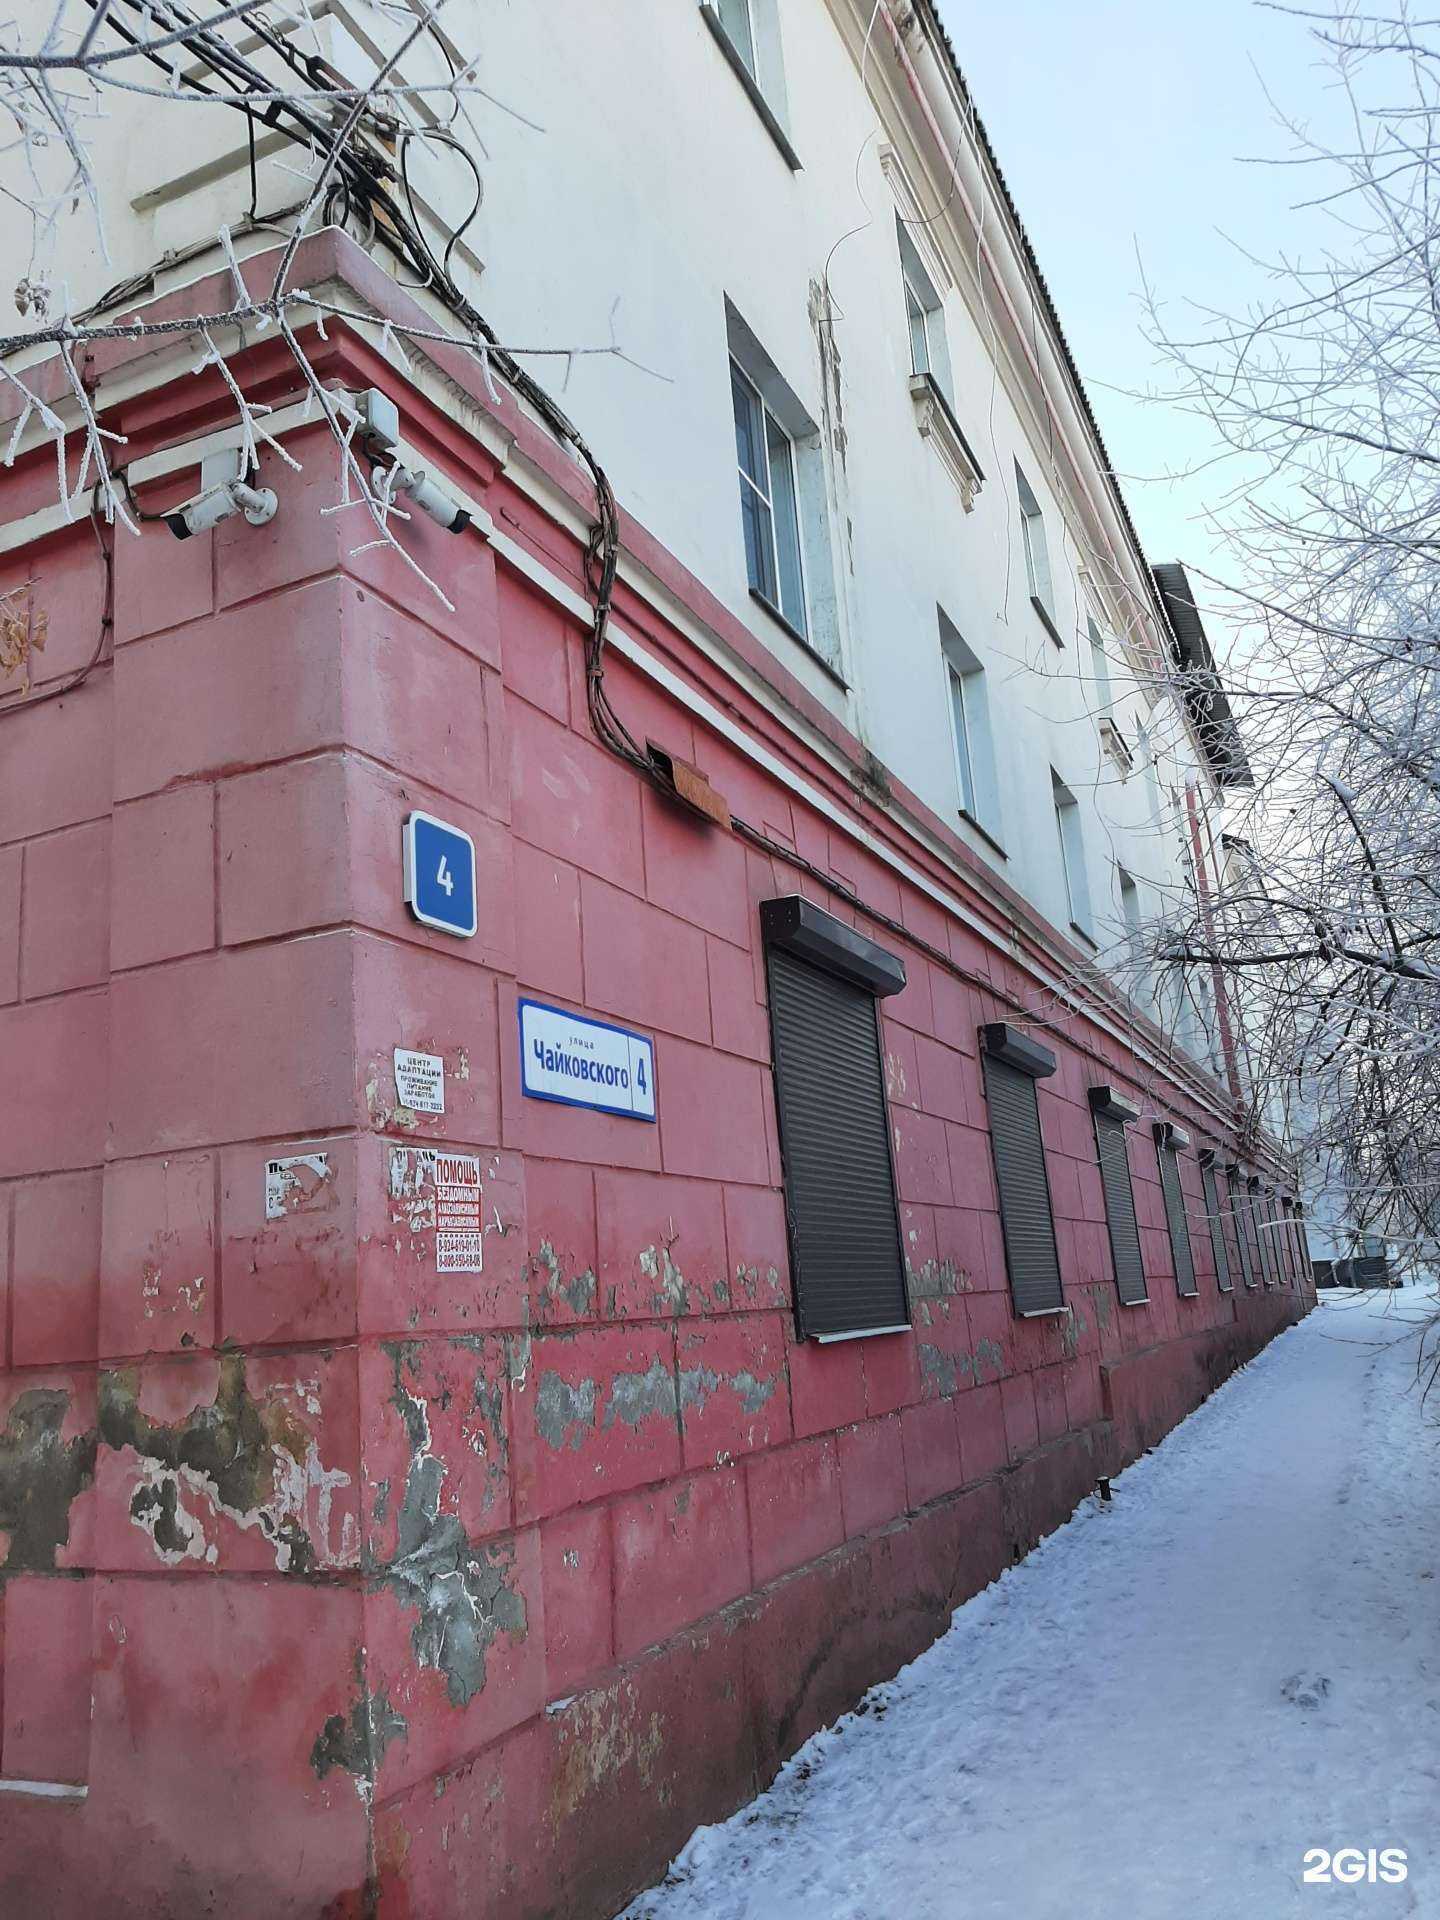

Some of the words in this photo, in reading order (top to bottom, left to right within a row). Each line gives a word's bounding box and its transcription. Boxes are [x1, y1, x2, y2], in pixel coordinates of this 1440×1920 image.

[437, 855, 453, 896] 4
[569, 1036, 594, 1049] улица
[407, 1057, 431, 1067] ЦЕНТР
[533, 1038, 629, 1089] Чайковского
[637, 1058, 646, 1095] 4
[397, 1064, 441, 1078] АДАПТАЦИИ
[437, 1159, 478, 1186] ПОМОЩЬ
[437, 1186, 480, 1202] БЕЗДОМНЫМ
